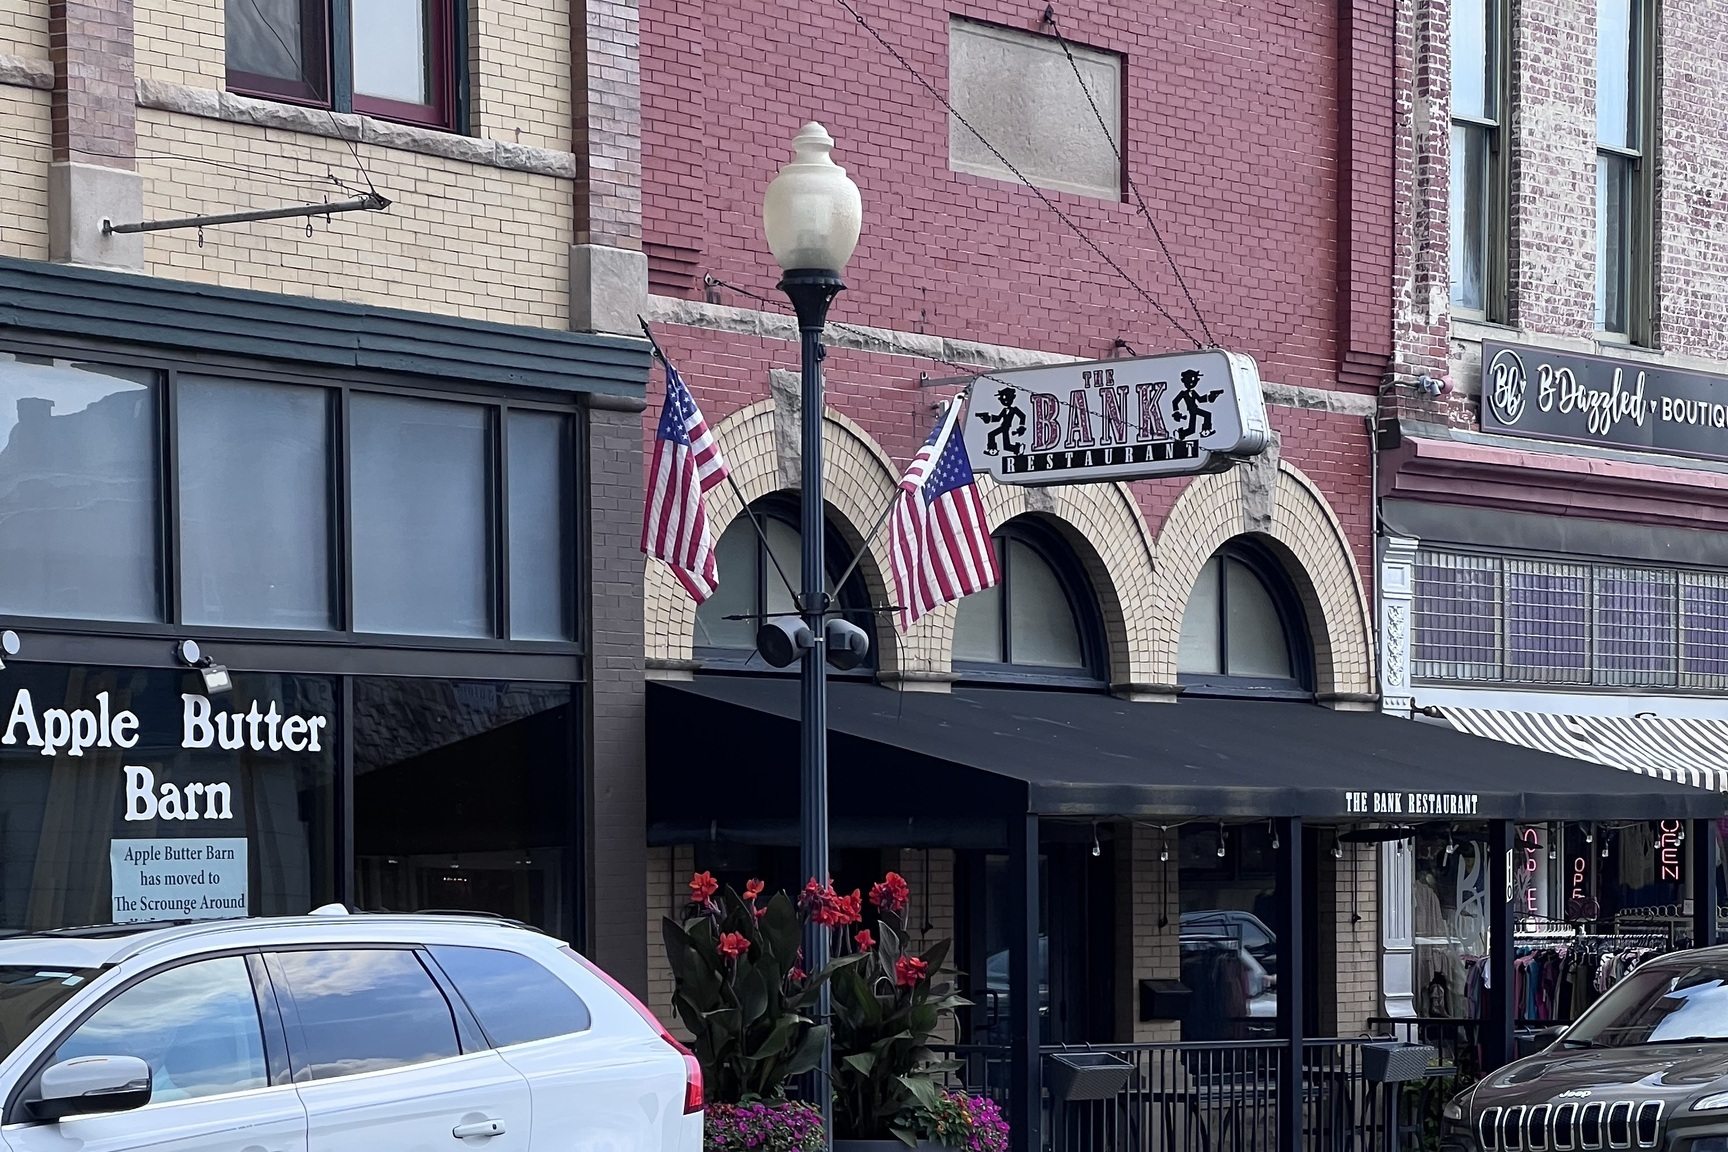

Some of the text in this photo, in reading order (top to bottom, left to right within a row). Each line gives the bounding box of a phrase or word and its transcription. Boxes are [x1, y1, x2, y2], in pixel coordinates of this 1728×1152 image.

[1082, 369, 1115, 389] THE
[1030, 382, 1170, 451] BANK
[1661, 396, 1728, 429] BOUTIQ
[1006, 441, 1196, 473] RESTAURANT
[1, 688, 327, 757] Apple Butter
[123, 765, 234, 821] Barn
[1345, 792, 1478, 815] THE BANK RESTAURANT
[124, 845, 235, 866] Apple Butter Barn
[1524, 828, 1538, 911] OPE
[140, 869, 220, 886] has moved to
[1572, 857, 1586, 899] OPE
[114, 893, 246, 915] The Scrounge Around
[1559, 1089, 1592, 1099] Jeep
